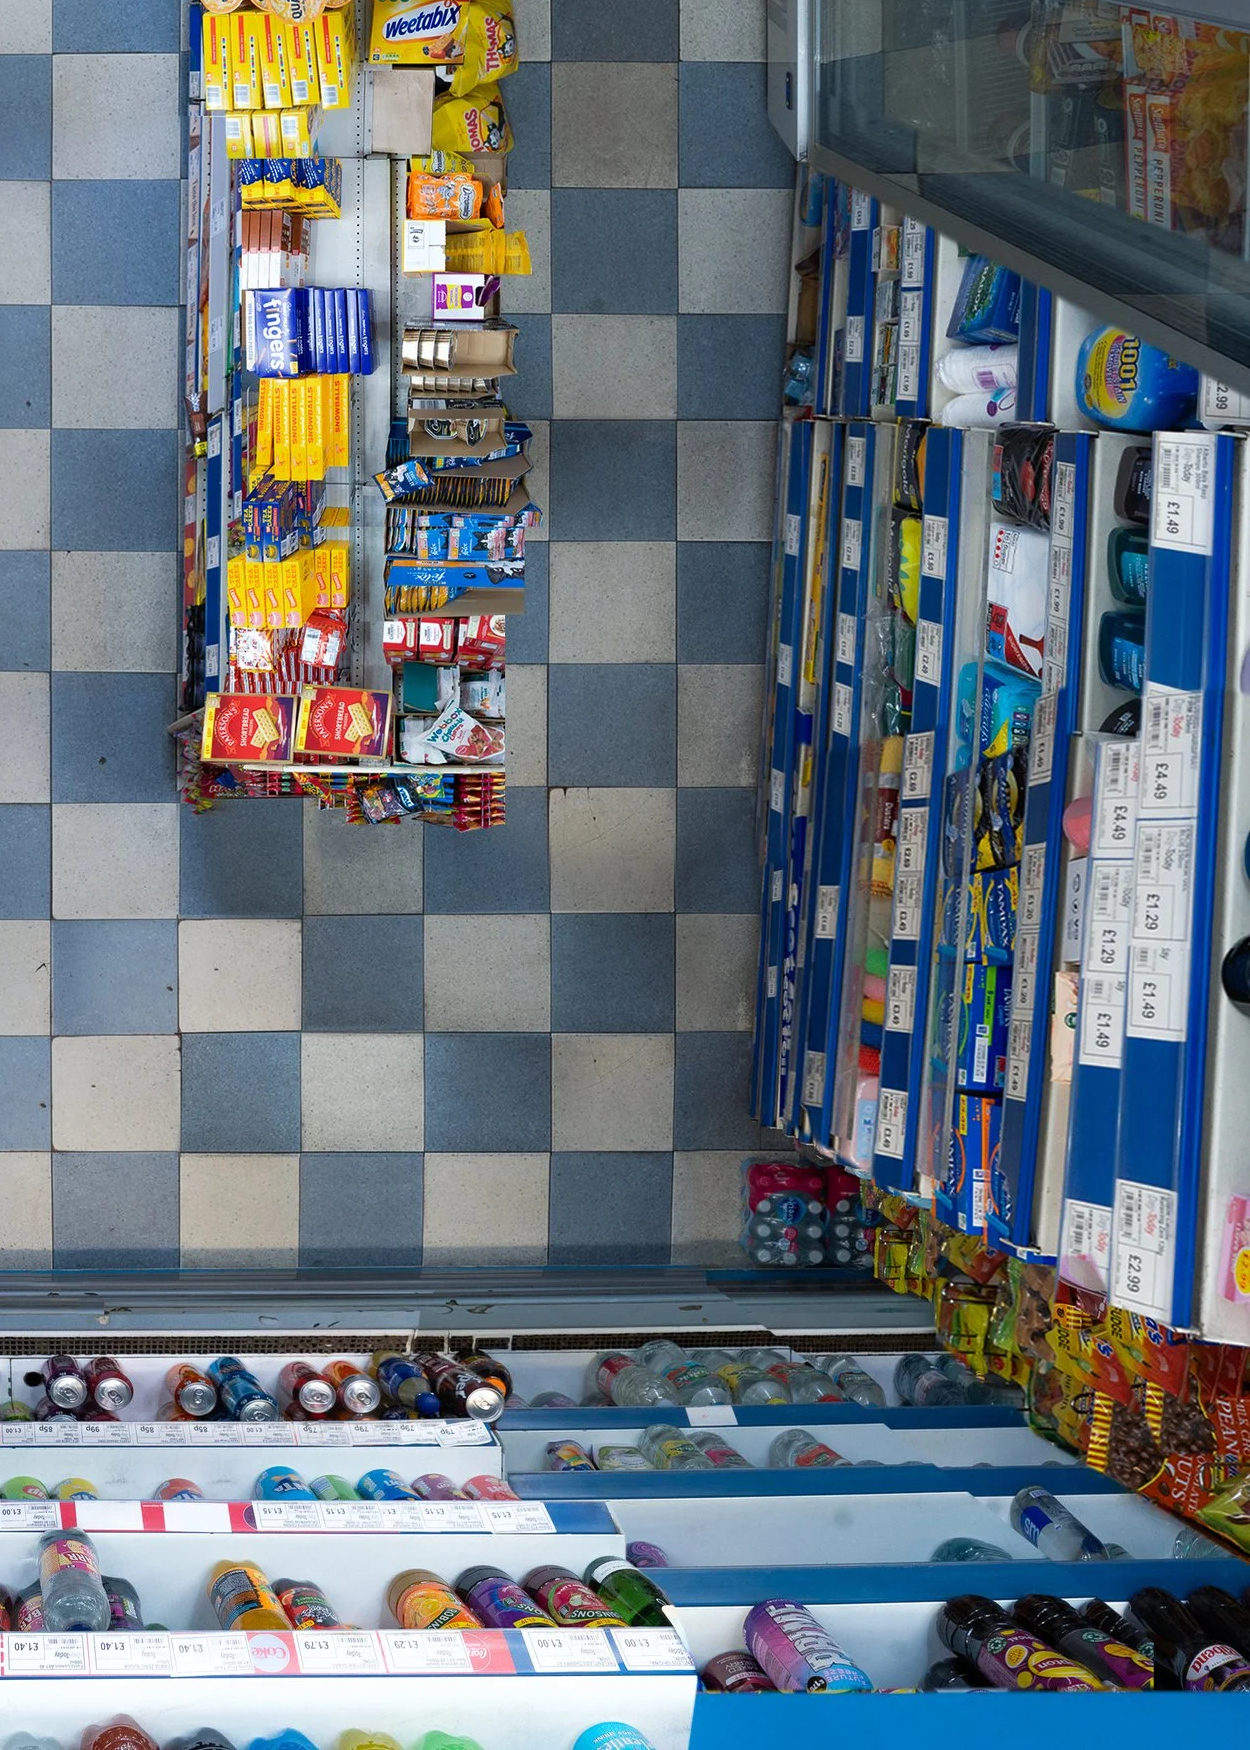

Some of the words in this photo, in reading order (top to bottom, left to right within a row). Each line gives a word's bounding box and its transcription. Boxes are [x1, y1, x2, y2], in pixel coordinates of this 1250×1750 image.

[483, 16, 501, 74] THOMAS
[972, 265, 993, 315] RADOX
[262, 298, 286, 370] fingers
[1119, 338, 1141, 391] 1001
[274, 387, 282, 444] SNOWBALLS
[1167, 501, 1180, 535] £1.49
[225, 703, 239, 747] PATERSON'S
[240, 707, 250, 747] SHORTBREAD
[1154, 762, 1169, 800] £4.49
[1112, 804, 1128, 842] £4.49
[1145, 892, 1161, 931] £1.29
[1125, 1253, 1142, 1293] £2.99
[14, 1640, 39, 1653] £1.40
[250, 1644, 288, 1662] Coke
[303, 1639, 330, 1651] £1.79
